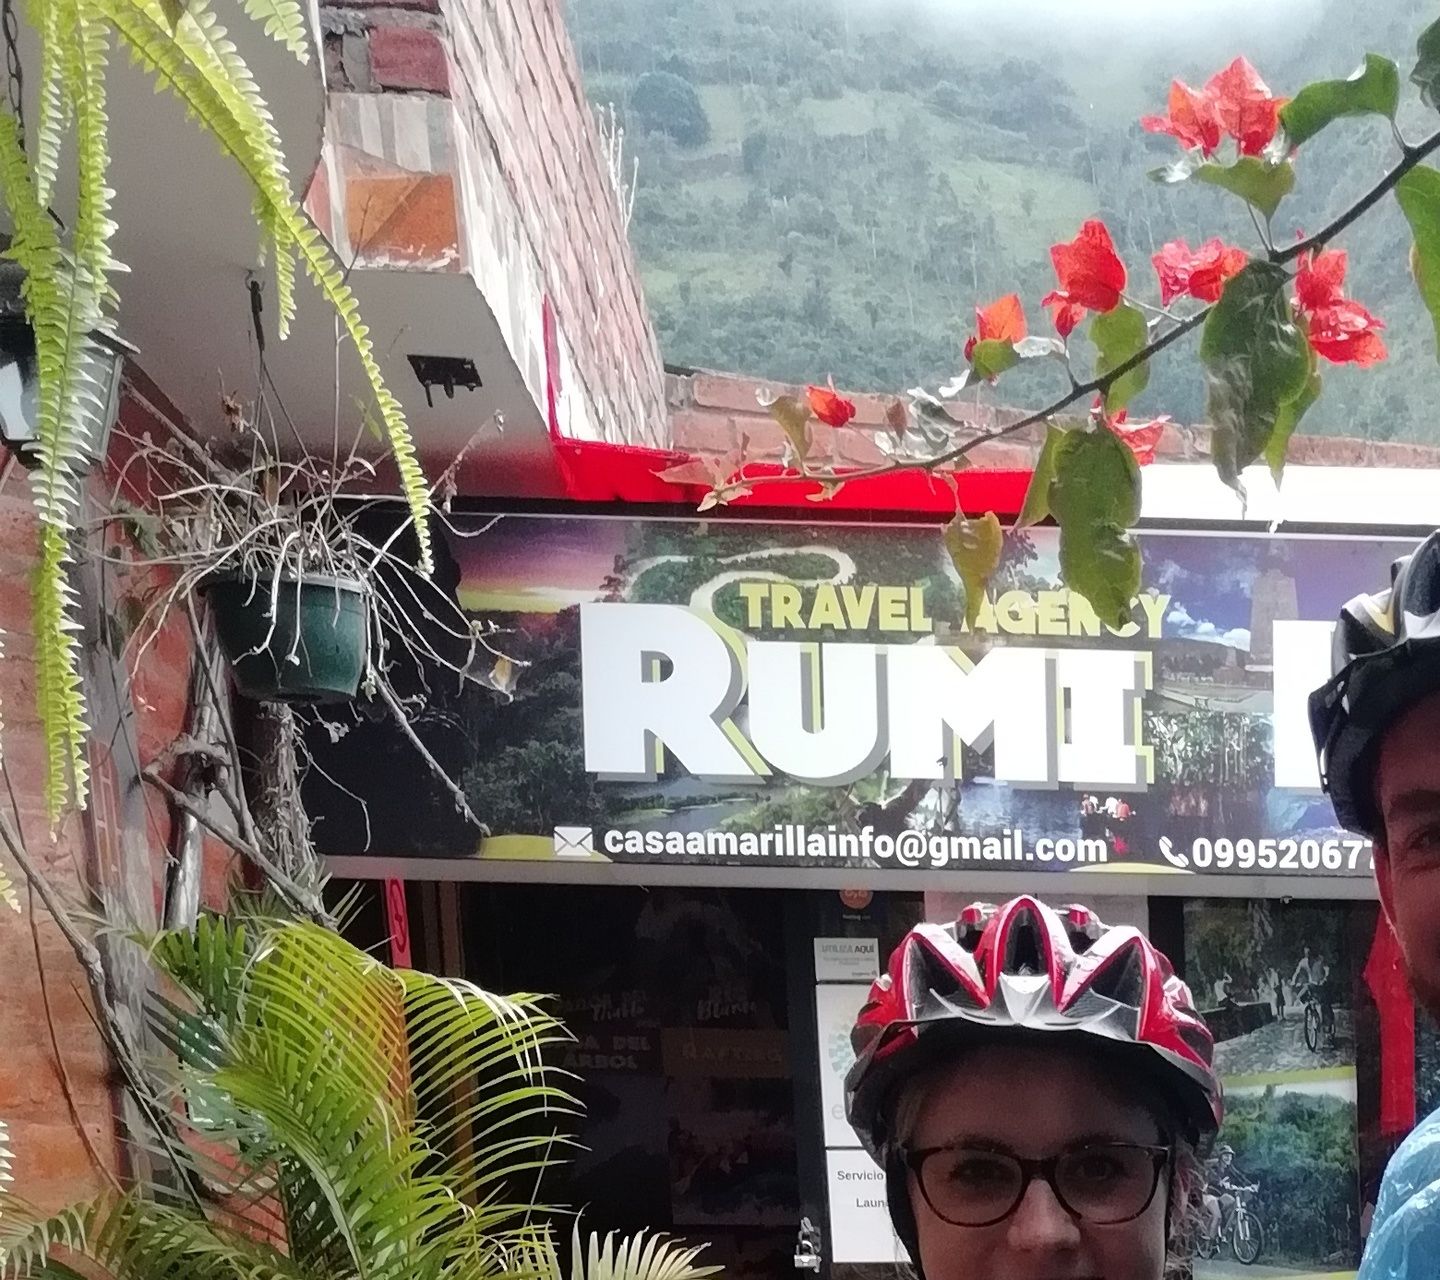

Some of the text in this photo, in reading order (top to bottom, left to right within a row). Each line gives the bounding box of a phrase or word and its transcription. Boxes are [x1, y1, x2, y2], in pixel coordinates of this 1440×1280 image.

[739, 583, 932, 632] TRAVEL
[580, 602, 1152, 789] RUMI
[603, 824, 1108, 866] casaamarillainfo@gmail.com
[837, 1170, 884, 1181] Servicio
